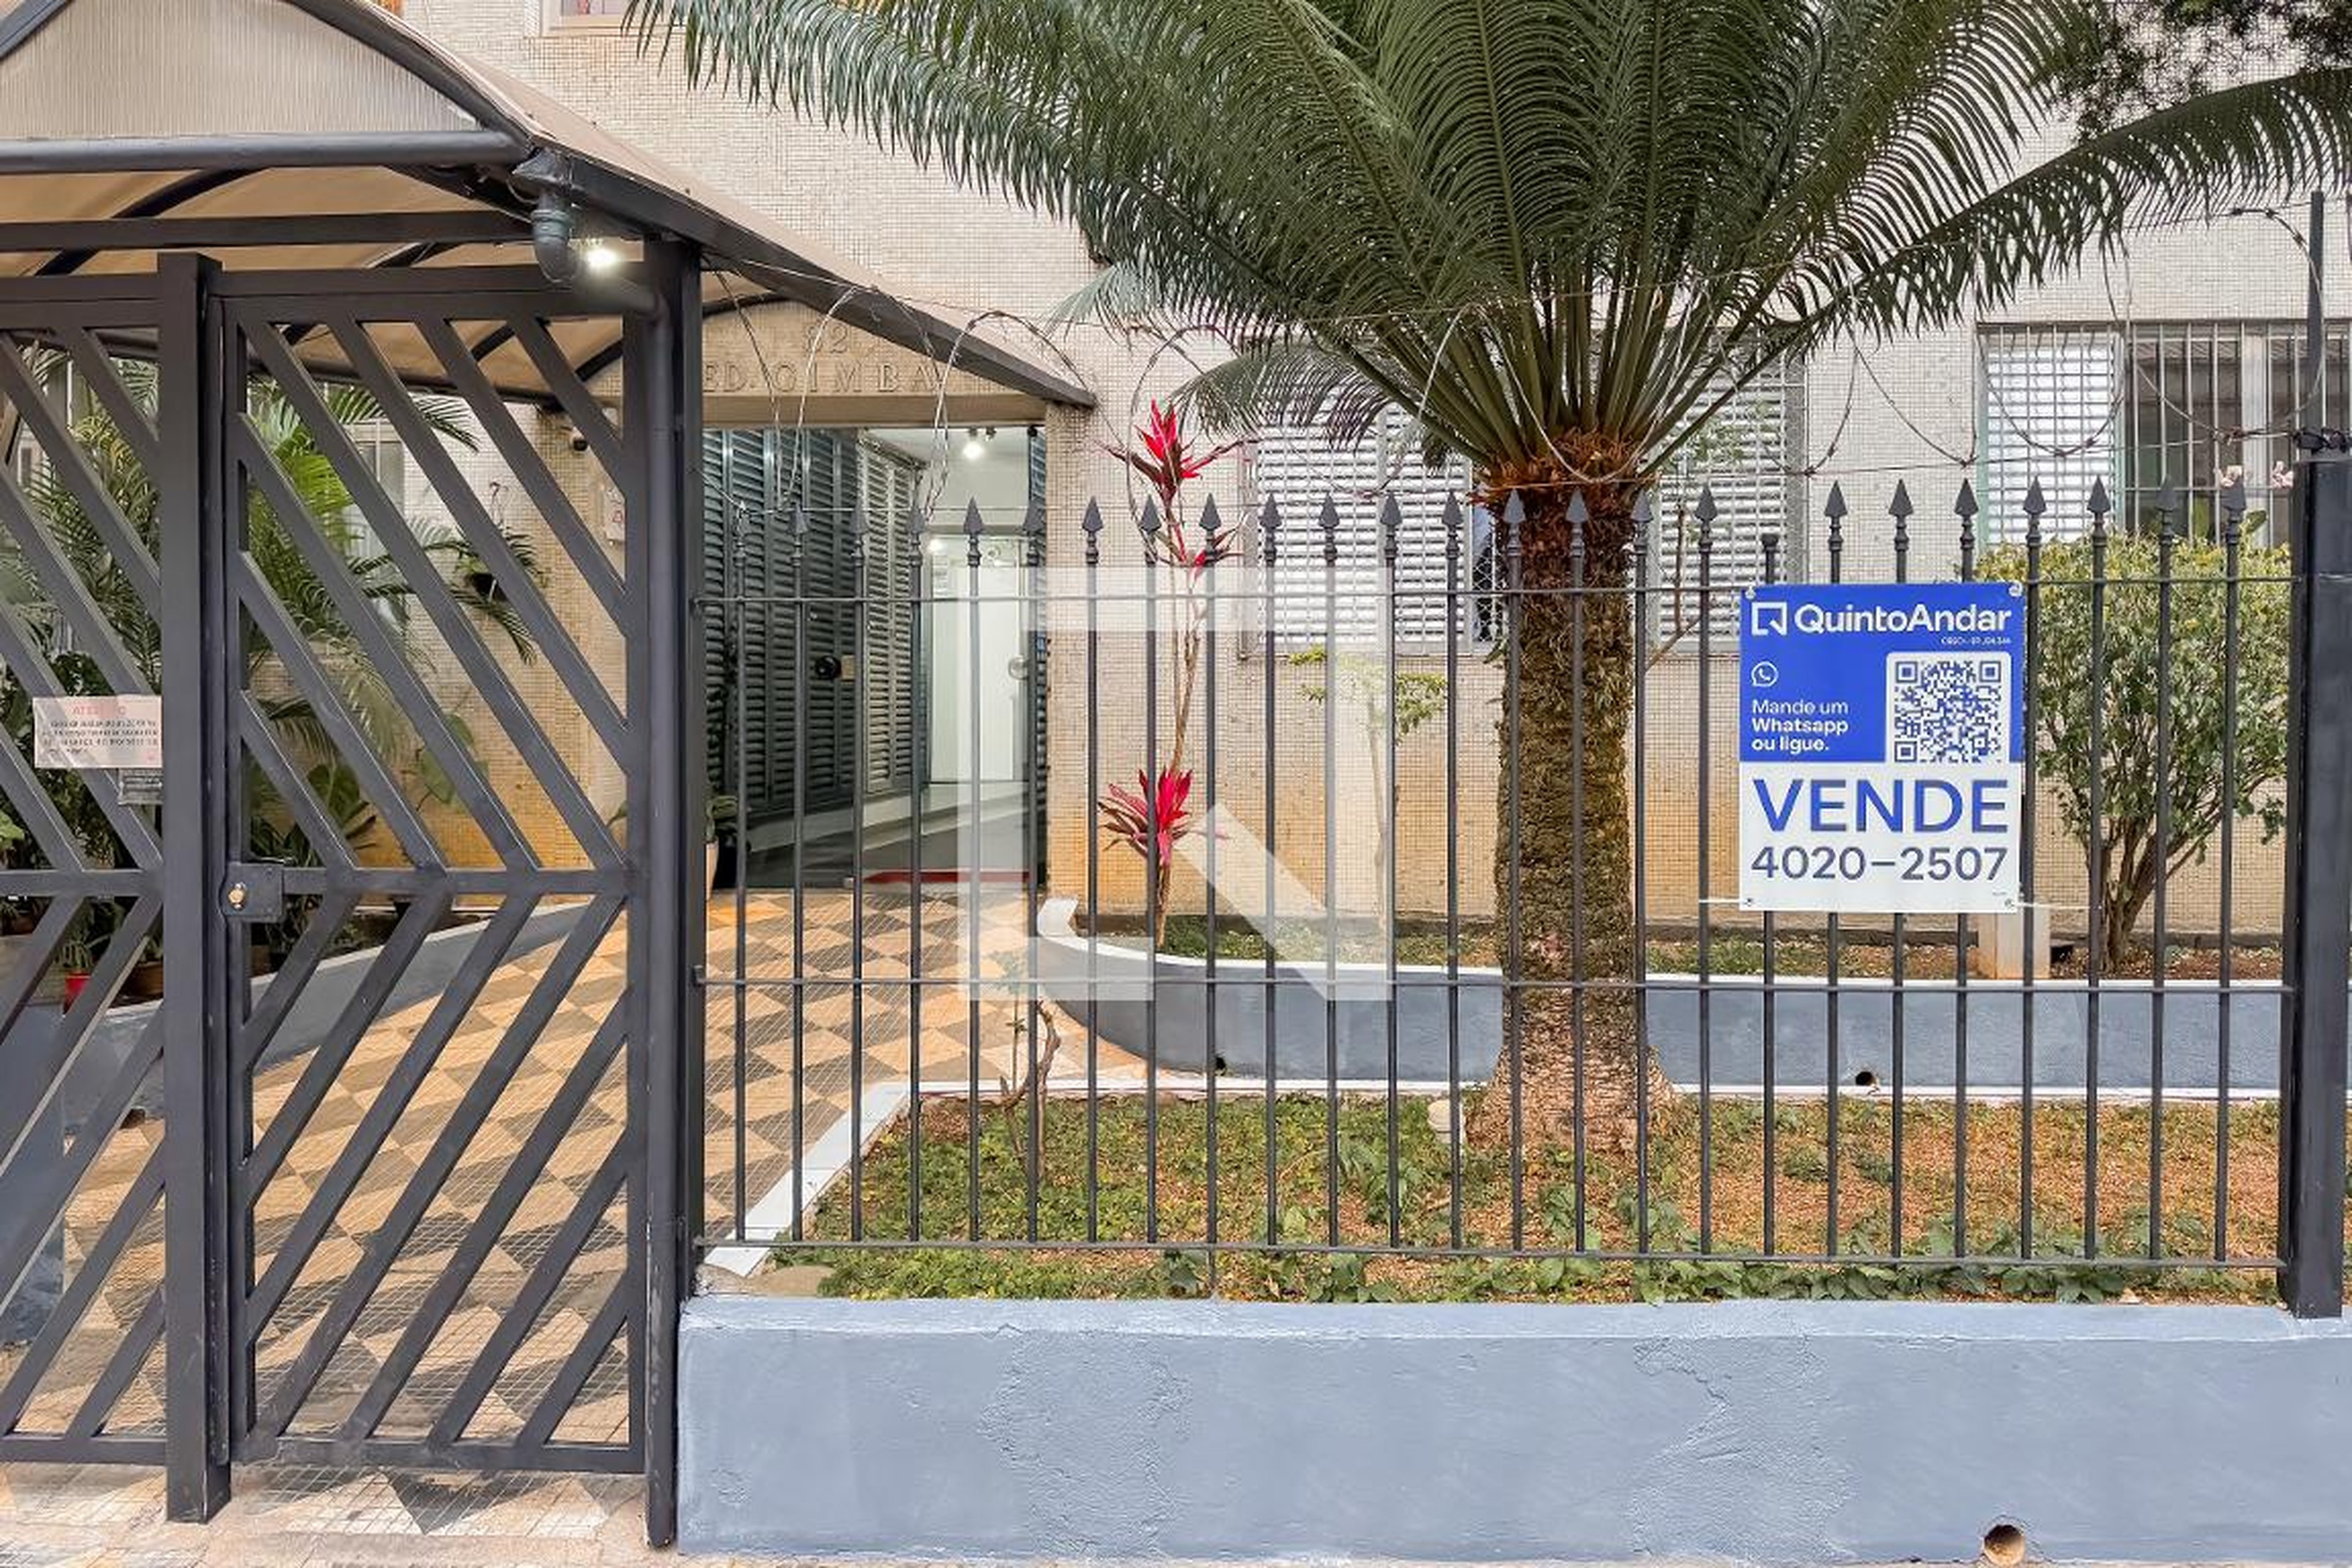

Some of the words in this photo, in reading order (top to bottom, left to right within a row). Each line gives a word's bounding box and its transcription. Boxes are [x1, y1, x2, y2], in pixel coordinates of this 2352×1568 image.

[1794, 604, 2011, 635] QuintoAndar
[1752, 699, 1815, 715] Mande
[1819, 703, 1849, 715] um
[1752, 717, 1849, 736] Whatsapp
[1752, 739, 1776, 751] ou
[1779, 736, 1830, 755] ligue.
[1754, 779, 2008, 833] VENDE
[1751, 846, 2008, 881] 4020-2507
